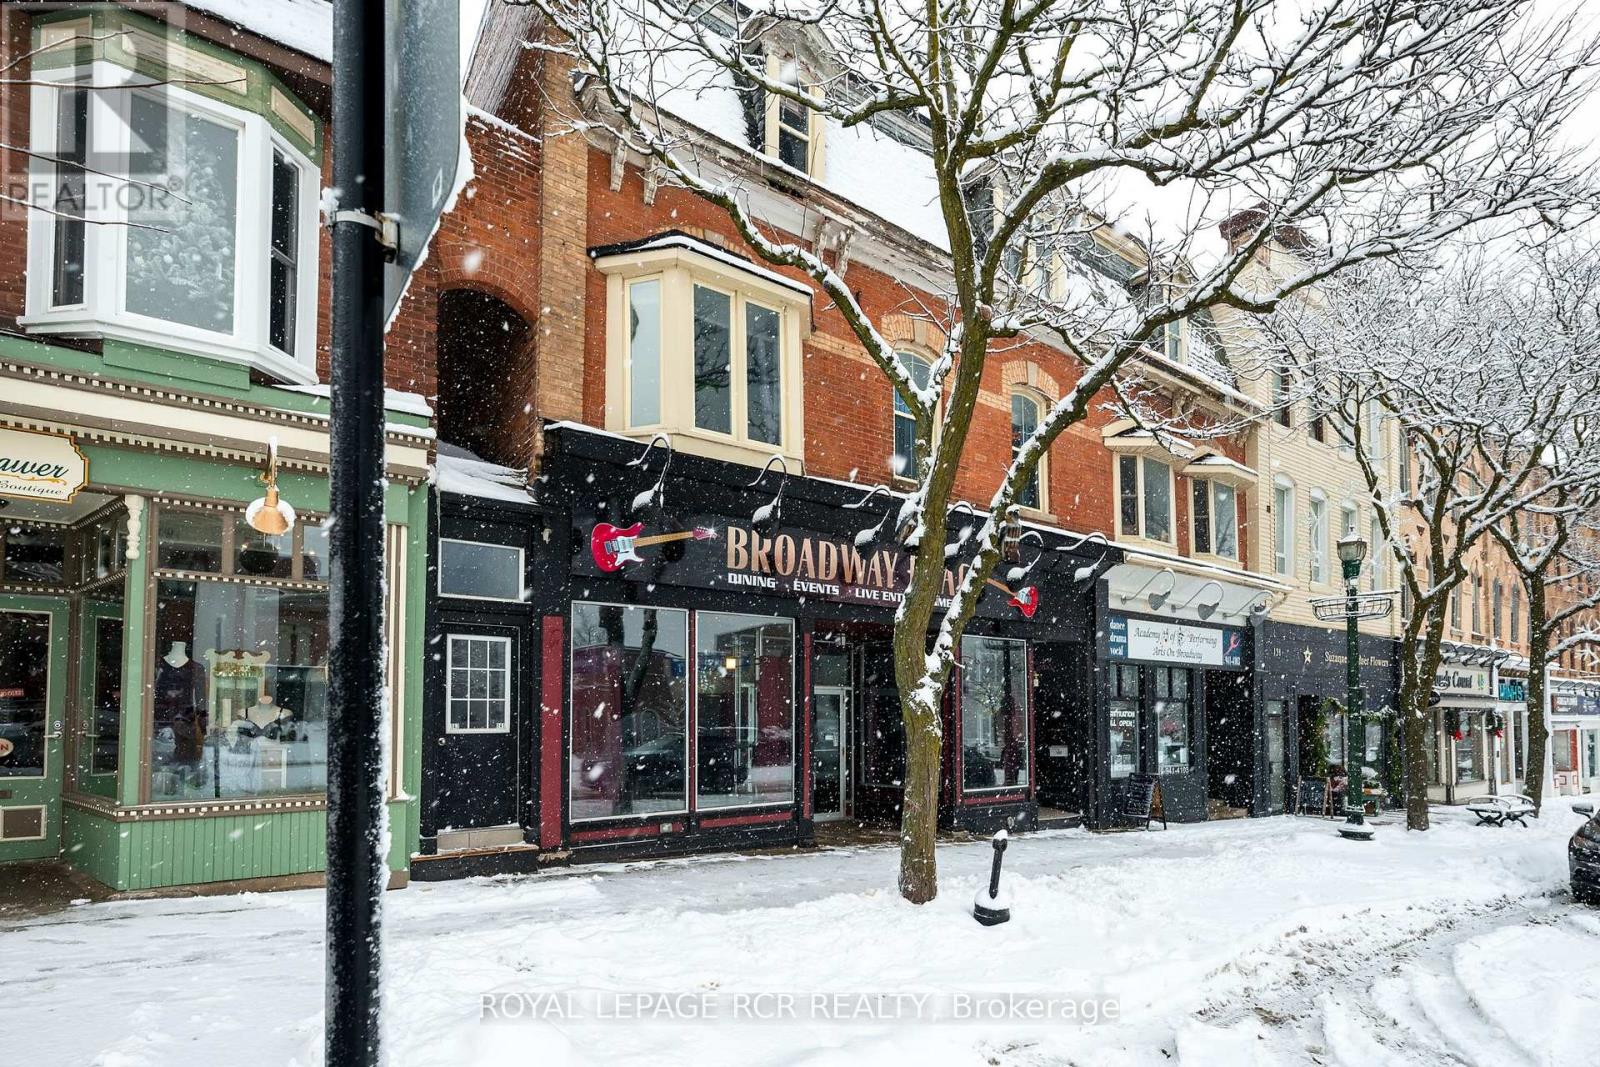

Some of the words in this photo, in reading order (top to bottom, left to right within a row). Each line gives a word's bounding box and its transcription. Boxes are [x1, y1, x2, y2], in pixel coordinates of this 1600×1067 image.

[727, 526, 898, 589] BROADWAY
[728, 573, 776, 589] DINING
[793, 579, 840, 596] EVENTS
[855, 588, 880, 600] LIVE
[1134, 627, 1160, 643] Academy
[1169, 630, 1176, 644] of
[1187, 631, 1217, 649] Performing
[1153, 646, 1166, 656] Arts
